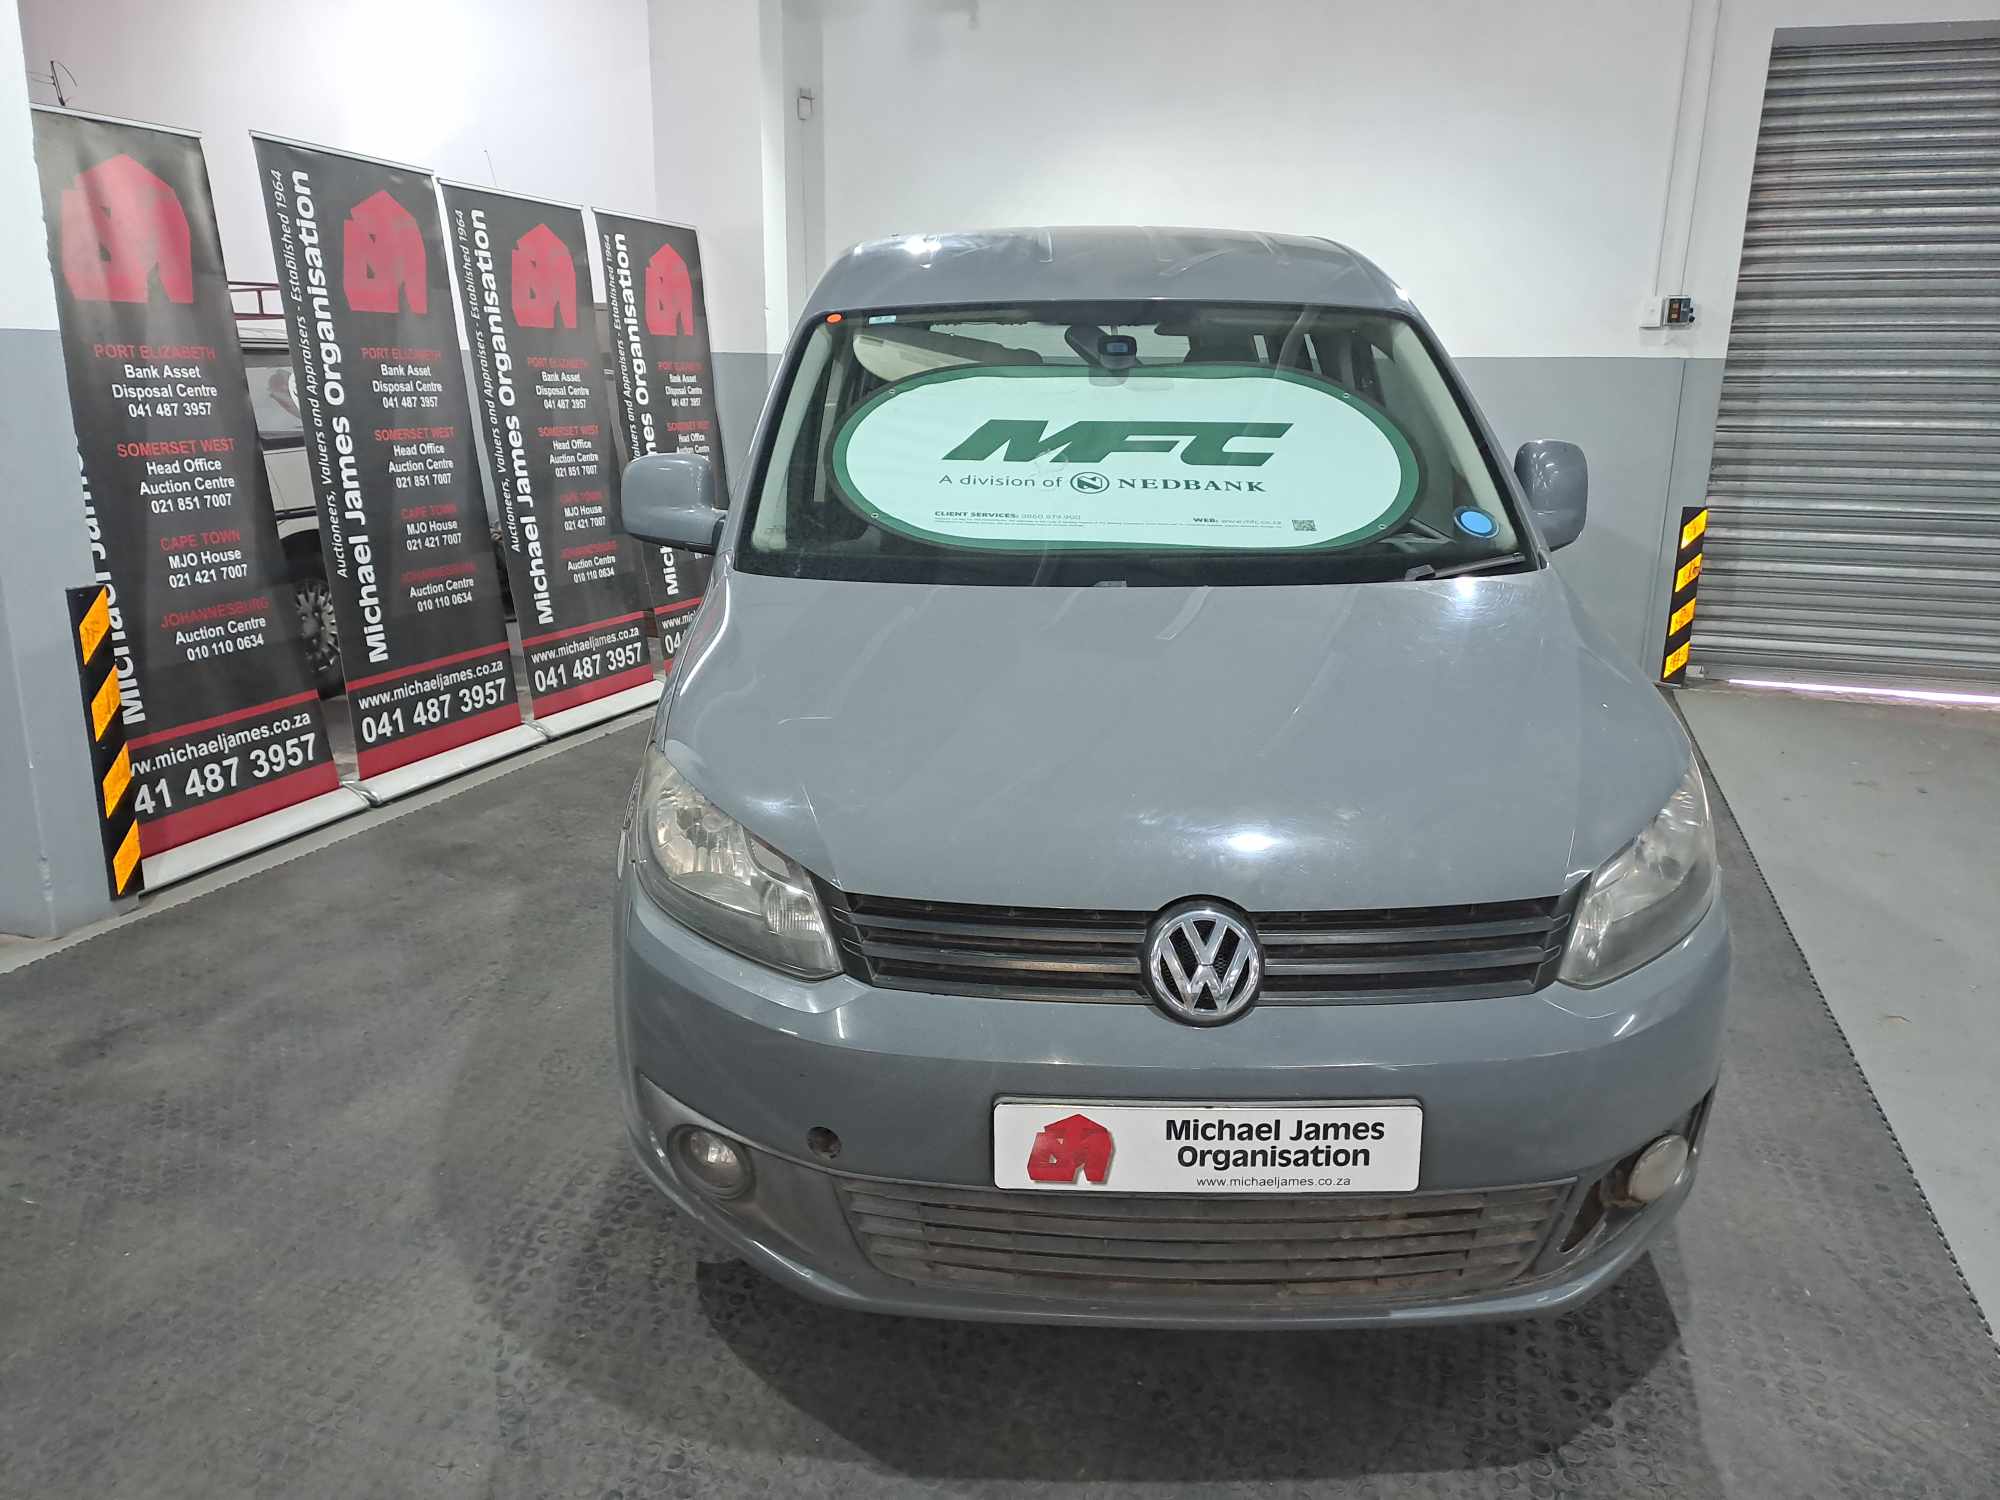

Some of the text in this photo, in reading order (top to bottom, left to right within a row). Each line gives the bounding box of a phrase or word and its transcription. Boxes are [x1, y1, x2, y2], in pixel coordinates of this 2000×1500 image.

[271, 169, 287, 210] 1964
[278, 213, 303, 303] Established
[460, 244, 481, 320] Established
[615, 233, 649, 406] Organisation
[94, 343, 135, 359] PORT
[296, 314, 320, 395] Appraisers
[124, 364, 202, 379] Bank Asset
[380, 364, 431, 377] Bank Asset
[474, 331, 494, 397] Appraisers
[112, 383, 218, 401] Disposal Centre
[372, 380, 442, 394] Disposal Centre
[128, 402, 212, 418] 041 487 3957
[308, 397, 324, 427] and
[382, 396, 399, 409] 041
[401, 396, 417, 408] 487
[487, 400, 498, 426] and
[292, 170, 389, 664] Michael James Organisation
[471, 209, 555, 625] Michael James Organisation
[116, 438, 236, 458] SOMERSET WEST
[393, 442, 444, 457] Head Office
[489, 427, 507, 473] Valuers
[941, 419, 1294, 466] MFC
[146, 458, 222, 476] Head Office
[315, 431, 332, 485] Valuers
[388, 459, 453, 473] Auction Centre
[139, 476, 235, 496] Auction Centre
[395, 477, 412, 488] 021
[414, 475, 430, 487] 851
[938, 475, 953, 485] A
[960, 475, 1035, 488] division
[1043, 476, 1063, 489] of
[1118, 478, 1267, 493] NEDBANK
[151, 493, 232, 514] 021 851 7007
[160, 528, 241, 551] CAPE TOWN
[323, 490, 348, 578] Auctioneers,
[406, 520, 458, 535] MJO House
[406, 533, 462, 551] 021 421 7007
[168, 549, 242, 570] MJO House
[168, 564, 248, 589] 021 421 7007
[409, 578, 474, 598] Auction Centre
[417, 591, 472, 612] 010 110 0634
[175, 616, 266, 645] Auction Centre
[187, 634, 265, 662] 010 110 0634
[531, 626, 639, 664] www.michaeljames.co.za
[534, 641, 642, 692] 041 487 3957
[358, 660, 504, 710] www.michaeljames.co.za
[361, 678, 507, 743] 041 487 3957
[184, 757, 240, 798] 487
[250, 732, 316, 779] 3957
[1166, 1119, 1385, 1142] Michael James
[1177, 1145, 1370, 1171] Organisation
[1196, 1176, 1351, 1188] www.michaeljames.co.za
